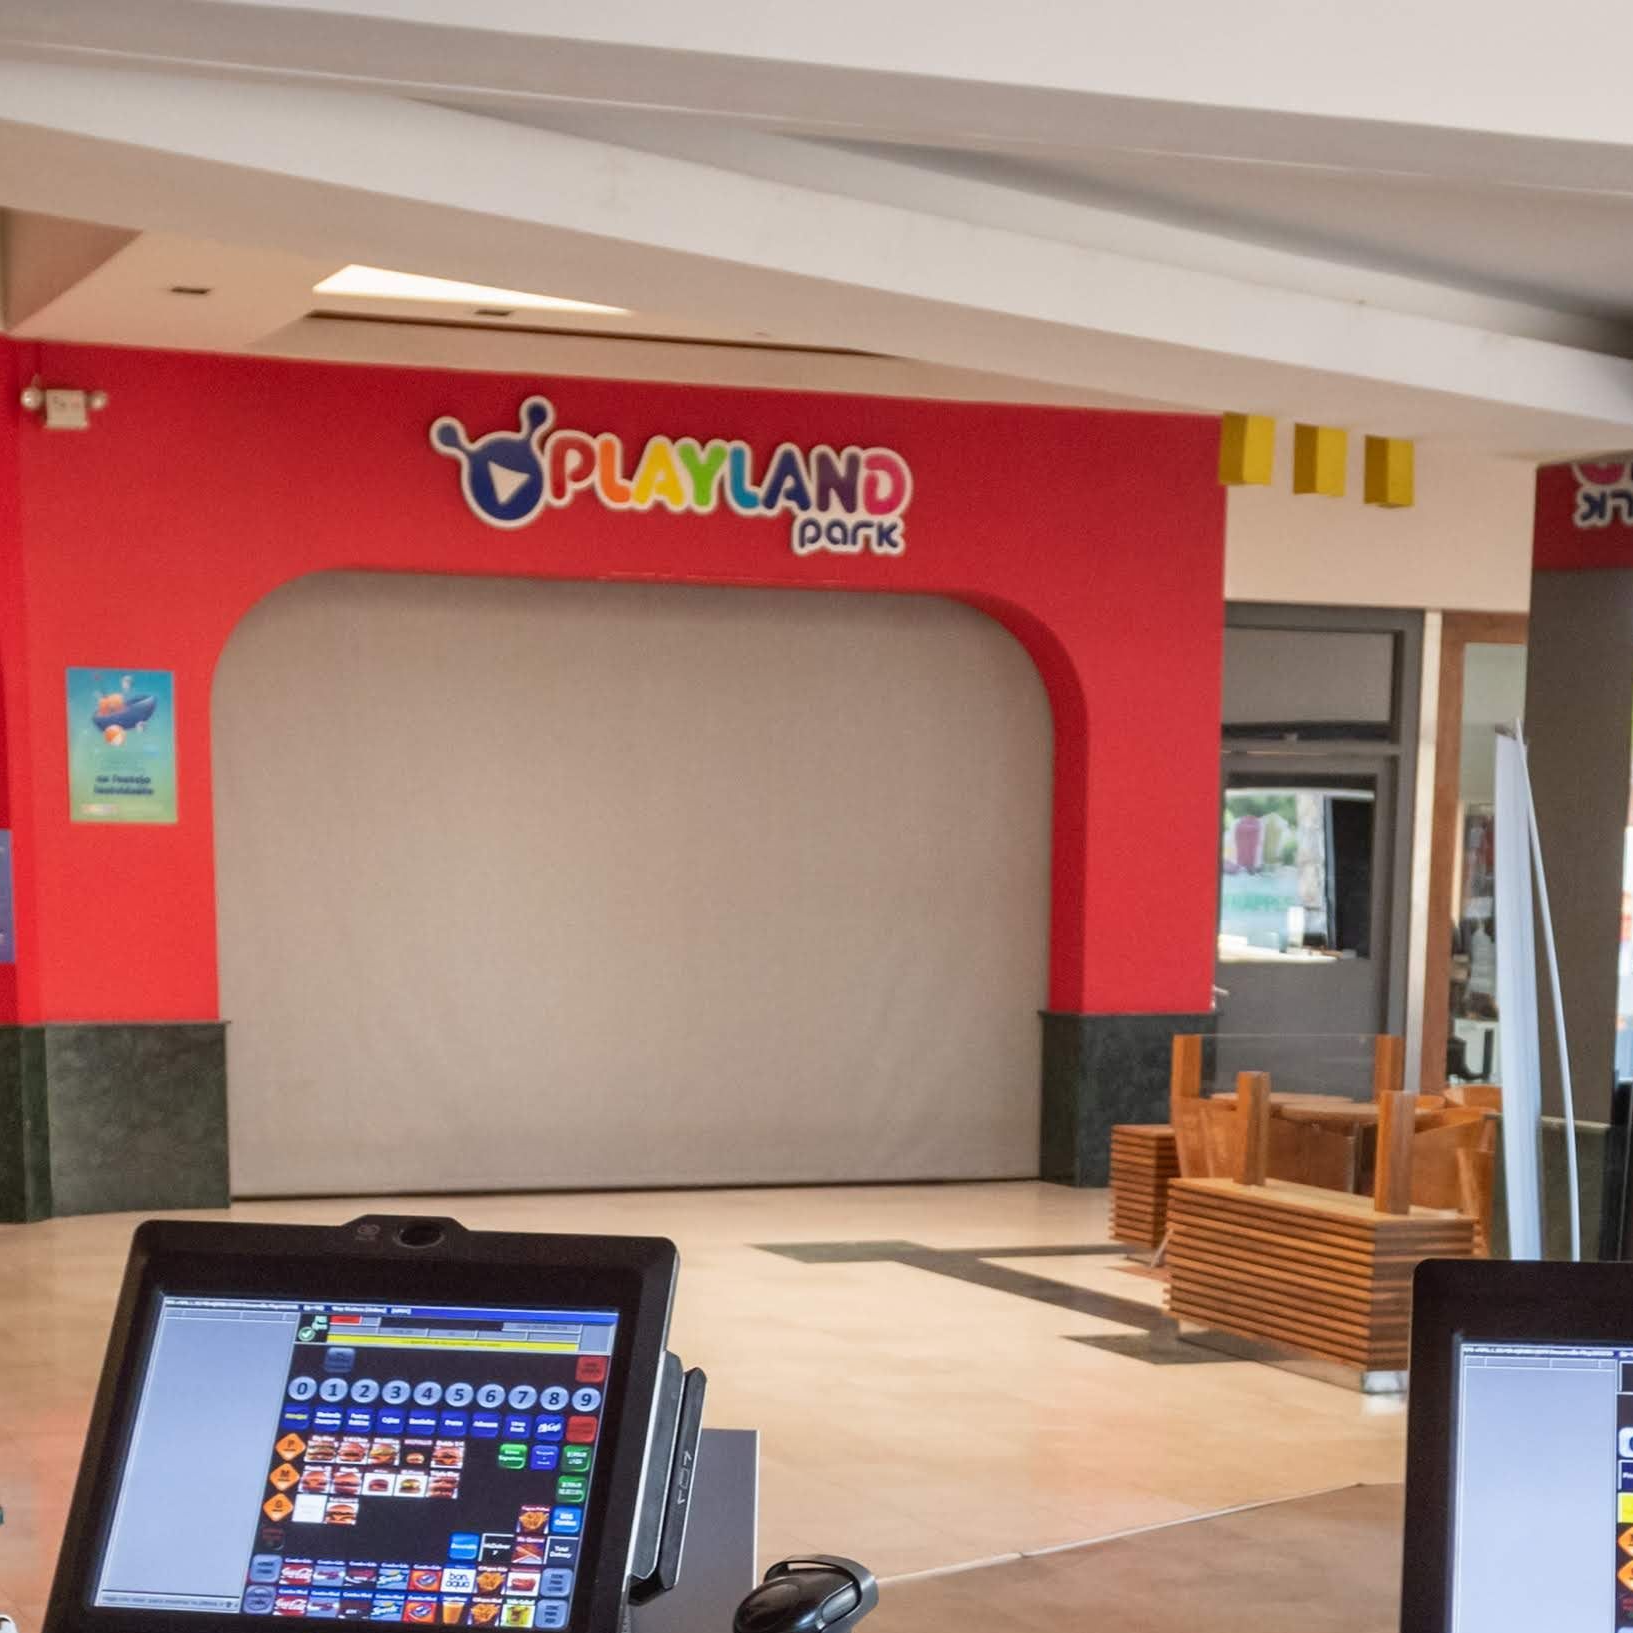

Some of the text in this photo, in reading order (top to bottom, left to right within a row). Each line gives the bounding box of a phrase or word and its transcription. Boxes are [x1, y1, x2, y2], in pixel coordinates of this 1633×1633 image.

[547, 431, 911, 518] PLAYLAND
[796, 516, 902, 550] park
[296, 1382, 592, 1406] 0 1 2 3 4 5 6 7 8 9
